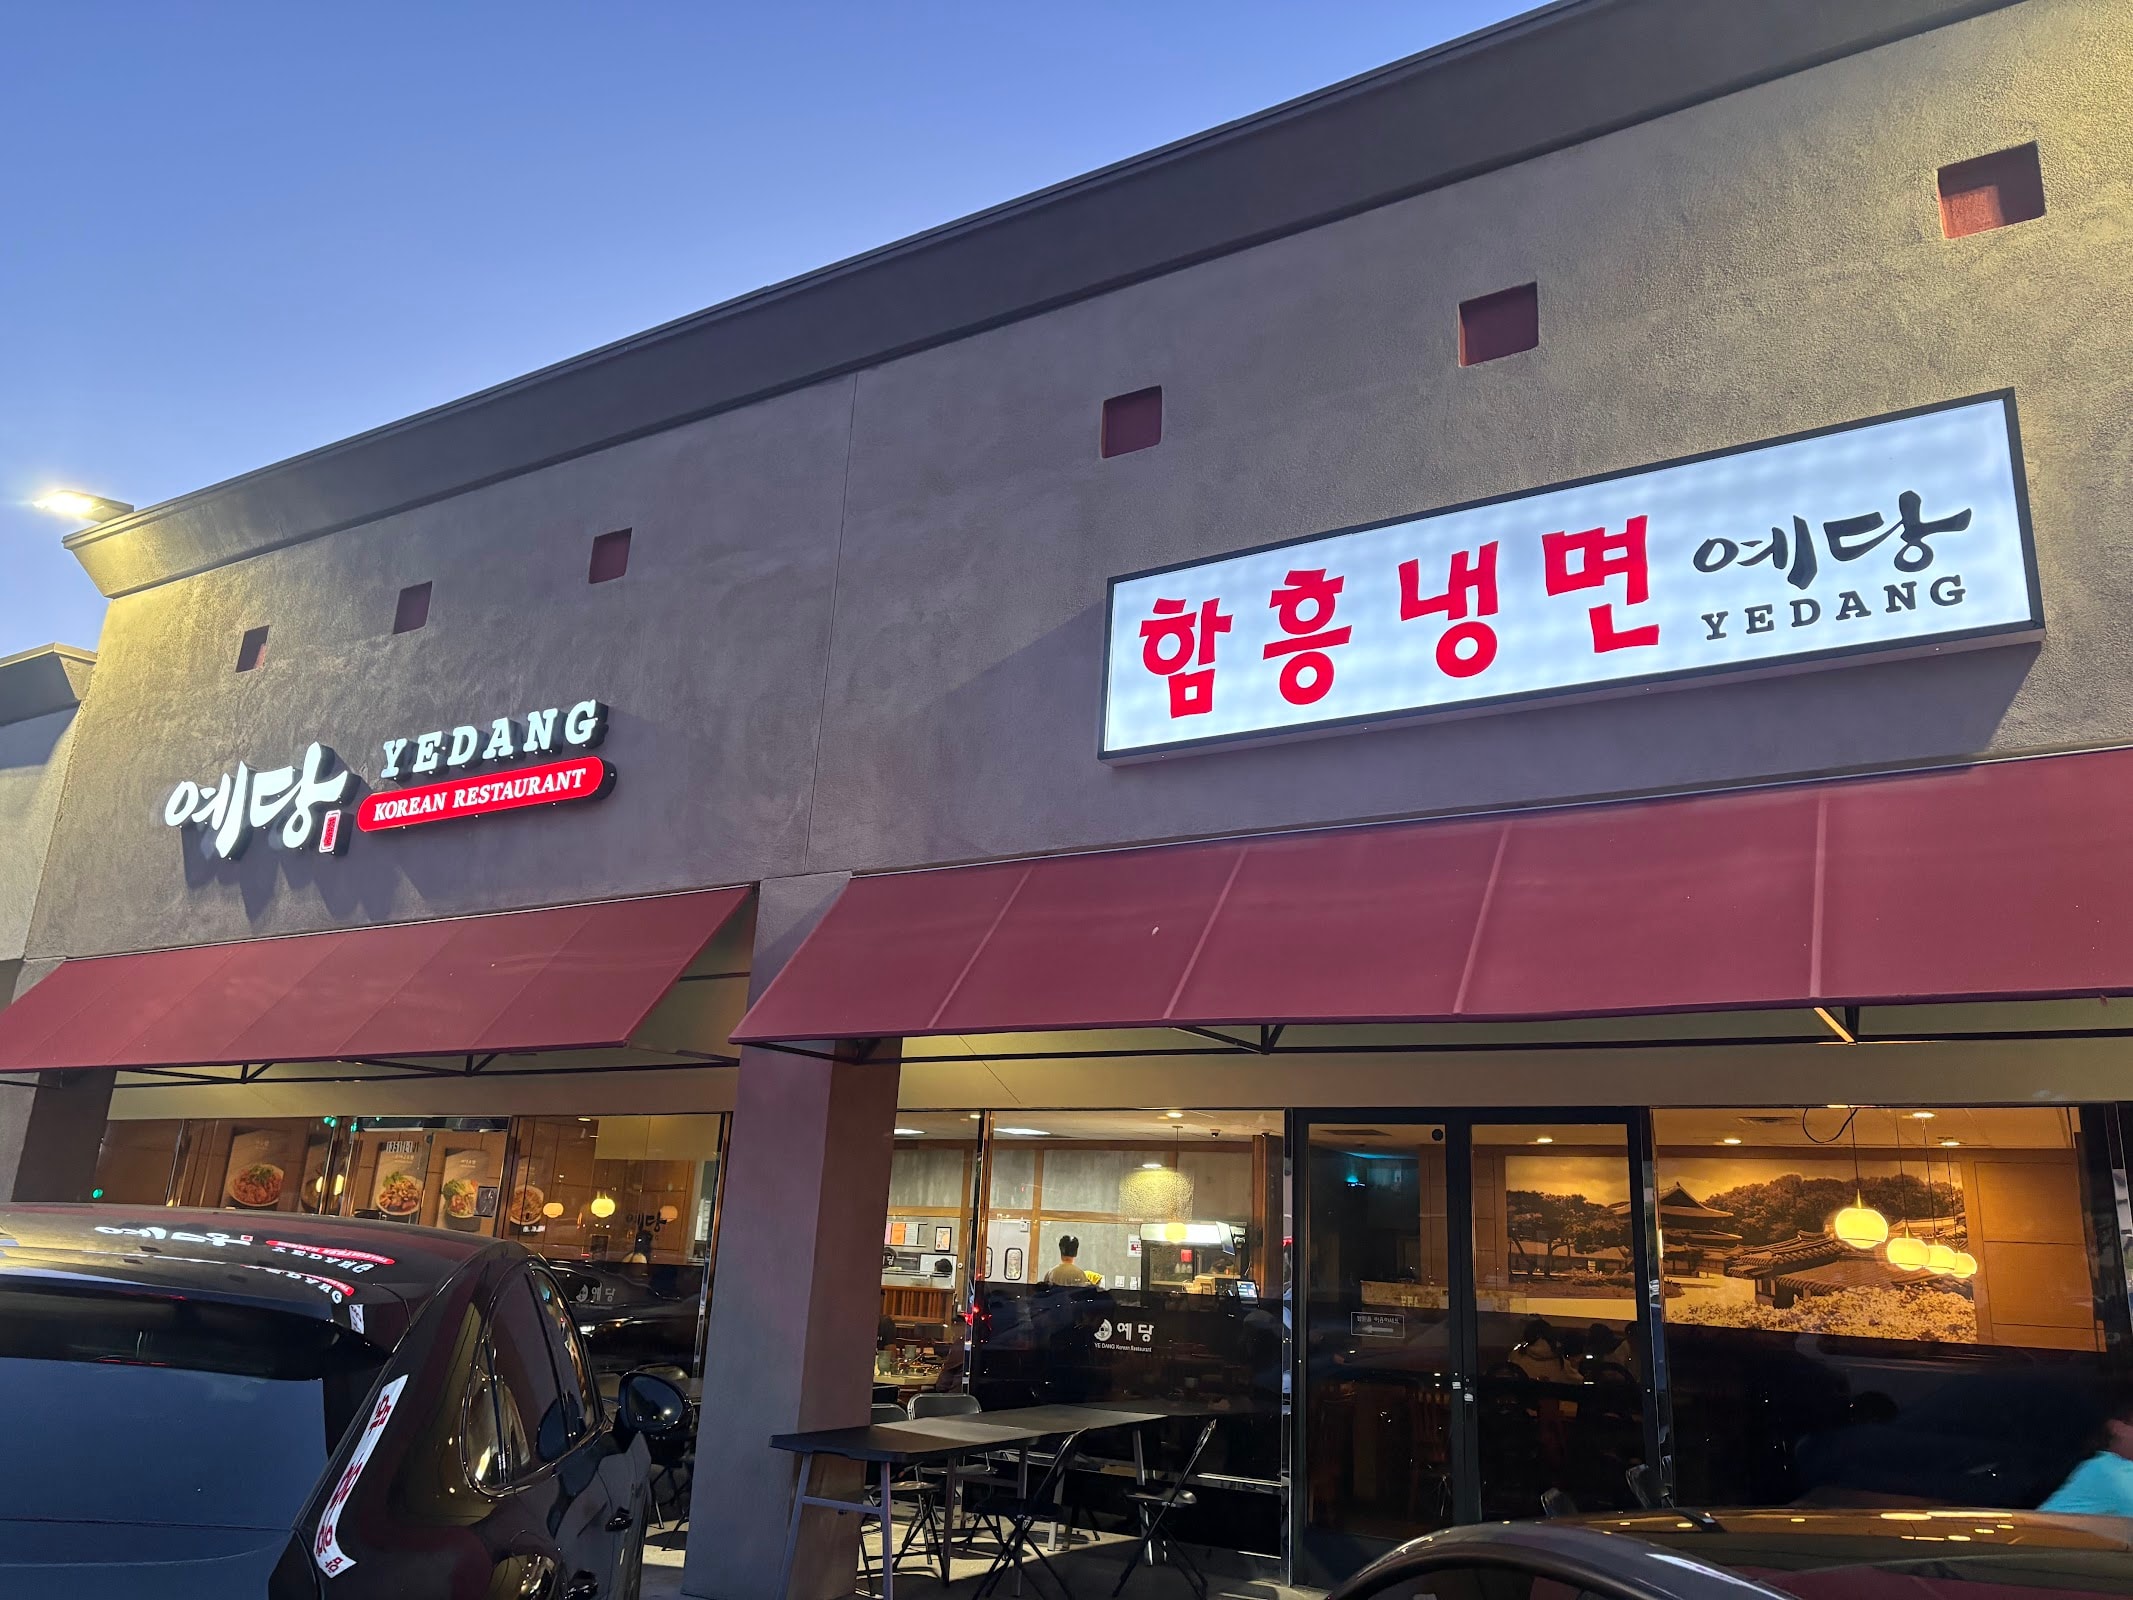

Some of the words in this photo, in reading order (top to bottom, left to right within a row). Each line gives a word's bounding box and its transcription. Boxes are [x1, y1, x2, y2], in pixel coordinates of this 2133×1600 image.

[1693, 490, 1972, 590] 예당
[1139, 514, 1660, 719] 함흥냉면
[1701, 574, 1966, 640] YEDANG
[381, 699, 597, 779] YEDANG
[165, 741, 348, 858] 예당
[372, 792, 448, 822] KOREAN
[453, 768, 587, 809] RESTAURANT
